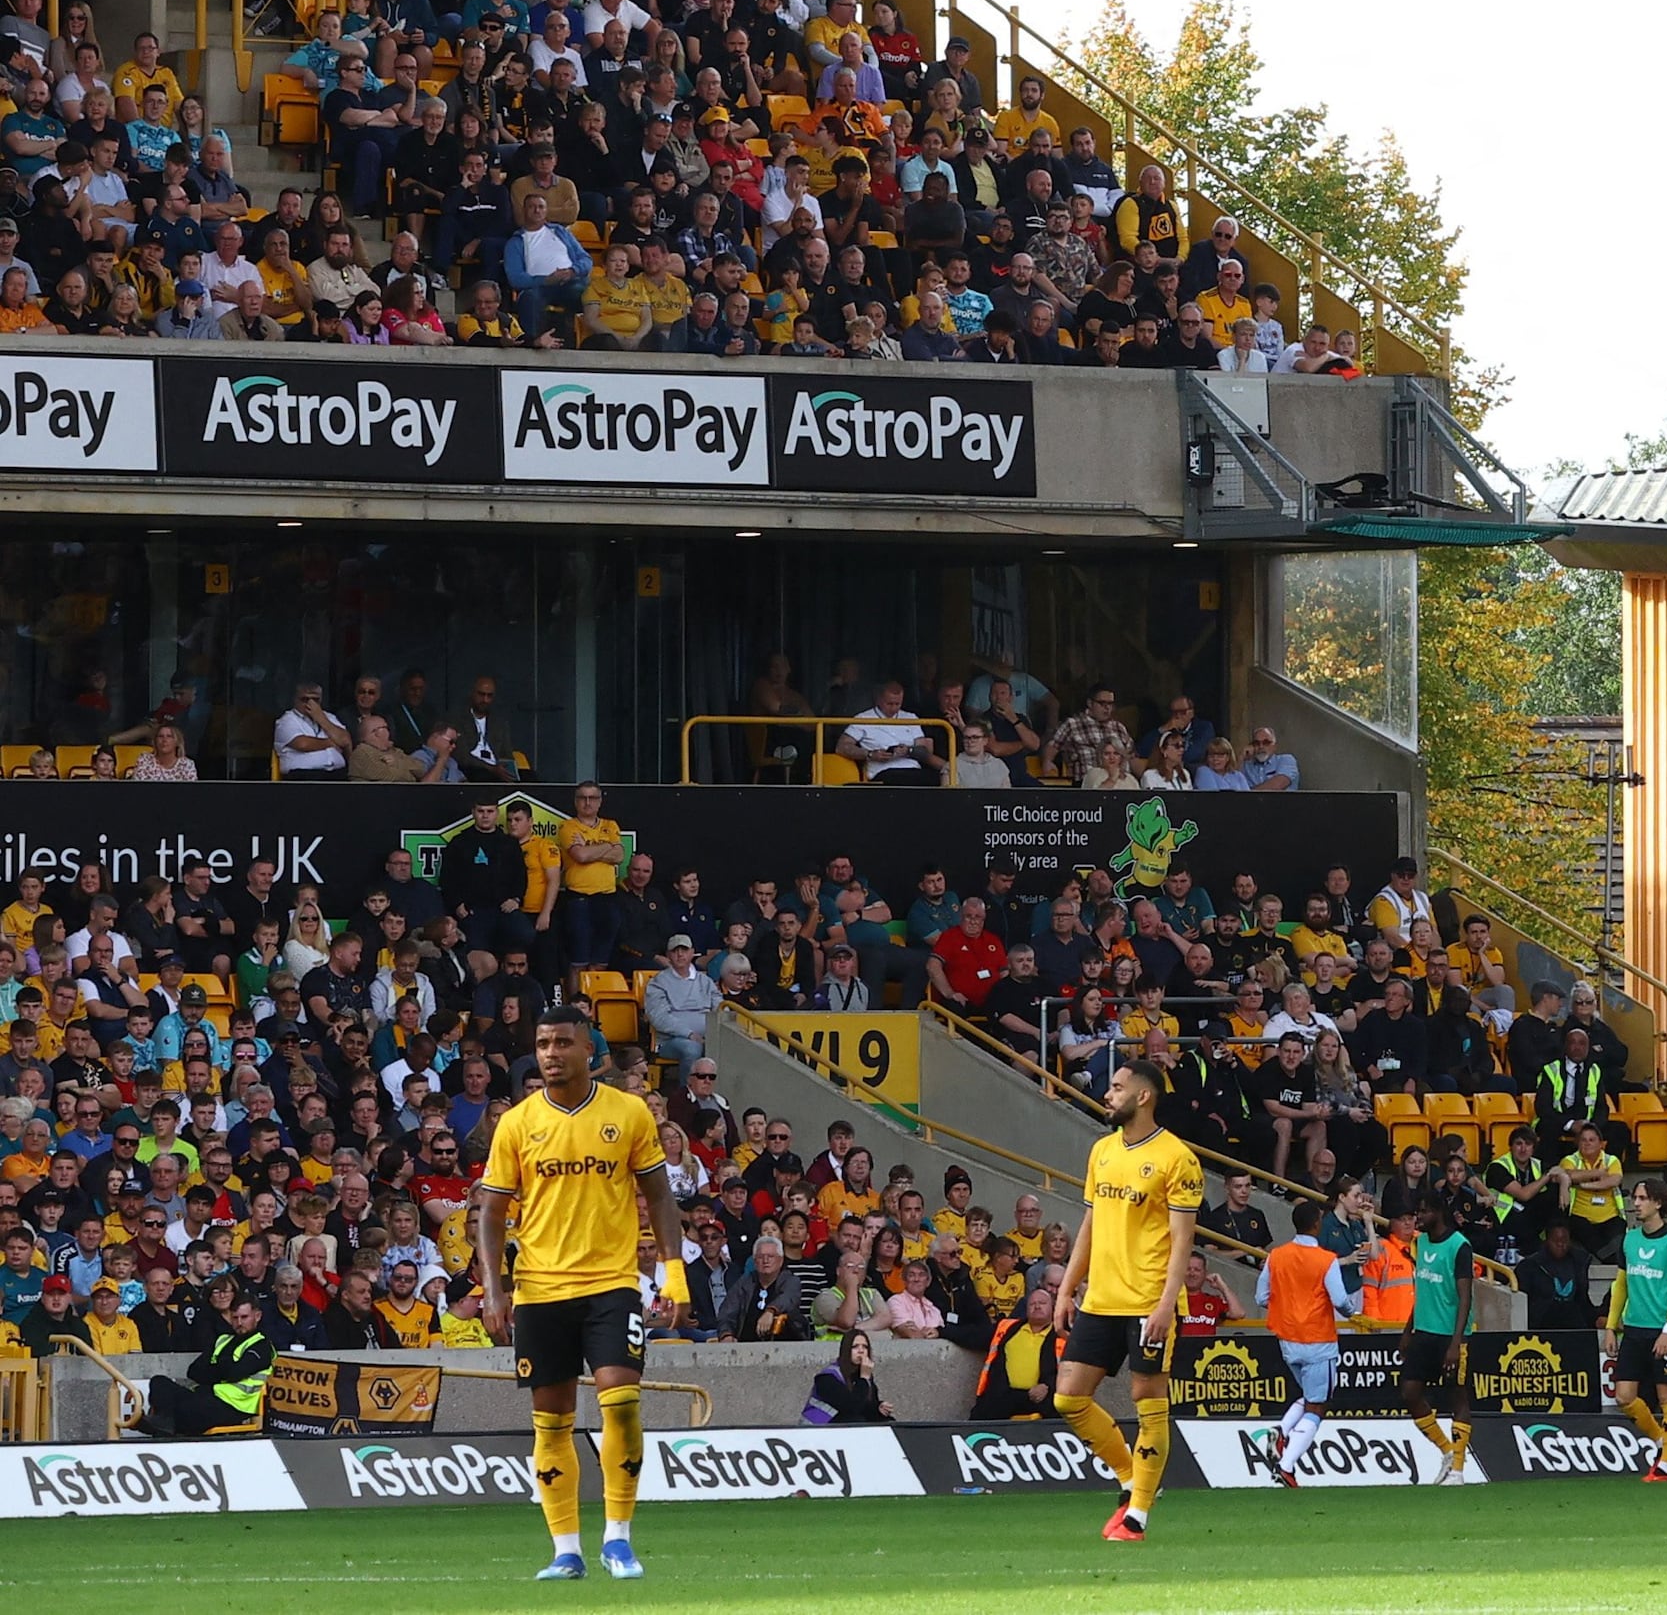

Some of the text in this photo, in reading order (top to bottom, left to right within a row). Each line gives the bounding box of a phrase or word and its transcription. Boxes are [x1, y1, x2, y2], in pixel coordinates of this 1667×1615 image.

[0, 371, 115, 457] Pay
[202, 375, 458, 467] AstroPay
[514, 384, 758, 472] AstroPay
[784, 390, 1024, 480] AstroPay
[532, 823, 558, 836] style
[984, 805, 1102, 826] Tile Choice proud
[984, 831, 1089, 848] sponsors of the
[0, 834, 325, 884] iles in the UK
[1029, 855, 1059, 869] area
[536, 1155, 618, 1179] AstroPay
[626, 1312, 644, 1346] 5
[1207, 1364, 1246, 1381] 305333
[1355, 1371, 1386, 1387] APP
[1511, 1358, 1549, 1376] 305333
[1168, 1376, 1286, 1406] WEDNESFIELD
[1473, 1371, 1589, 1400] WEDNESFIELD
[657, 1438, 853, 1498] AstroPay
[950, 1432, 1131, 1484] AstroPa
[1240, 1427, 1419, 1485] AtroPay
[22, 1454, 229, 1512] AstroPay
[339, 1445, 541, 1502] AstroPay
